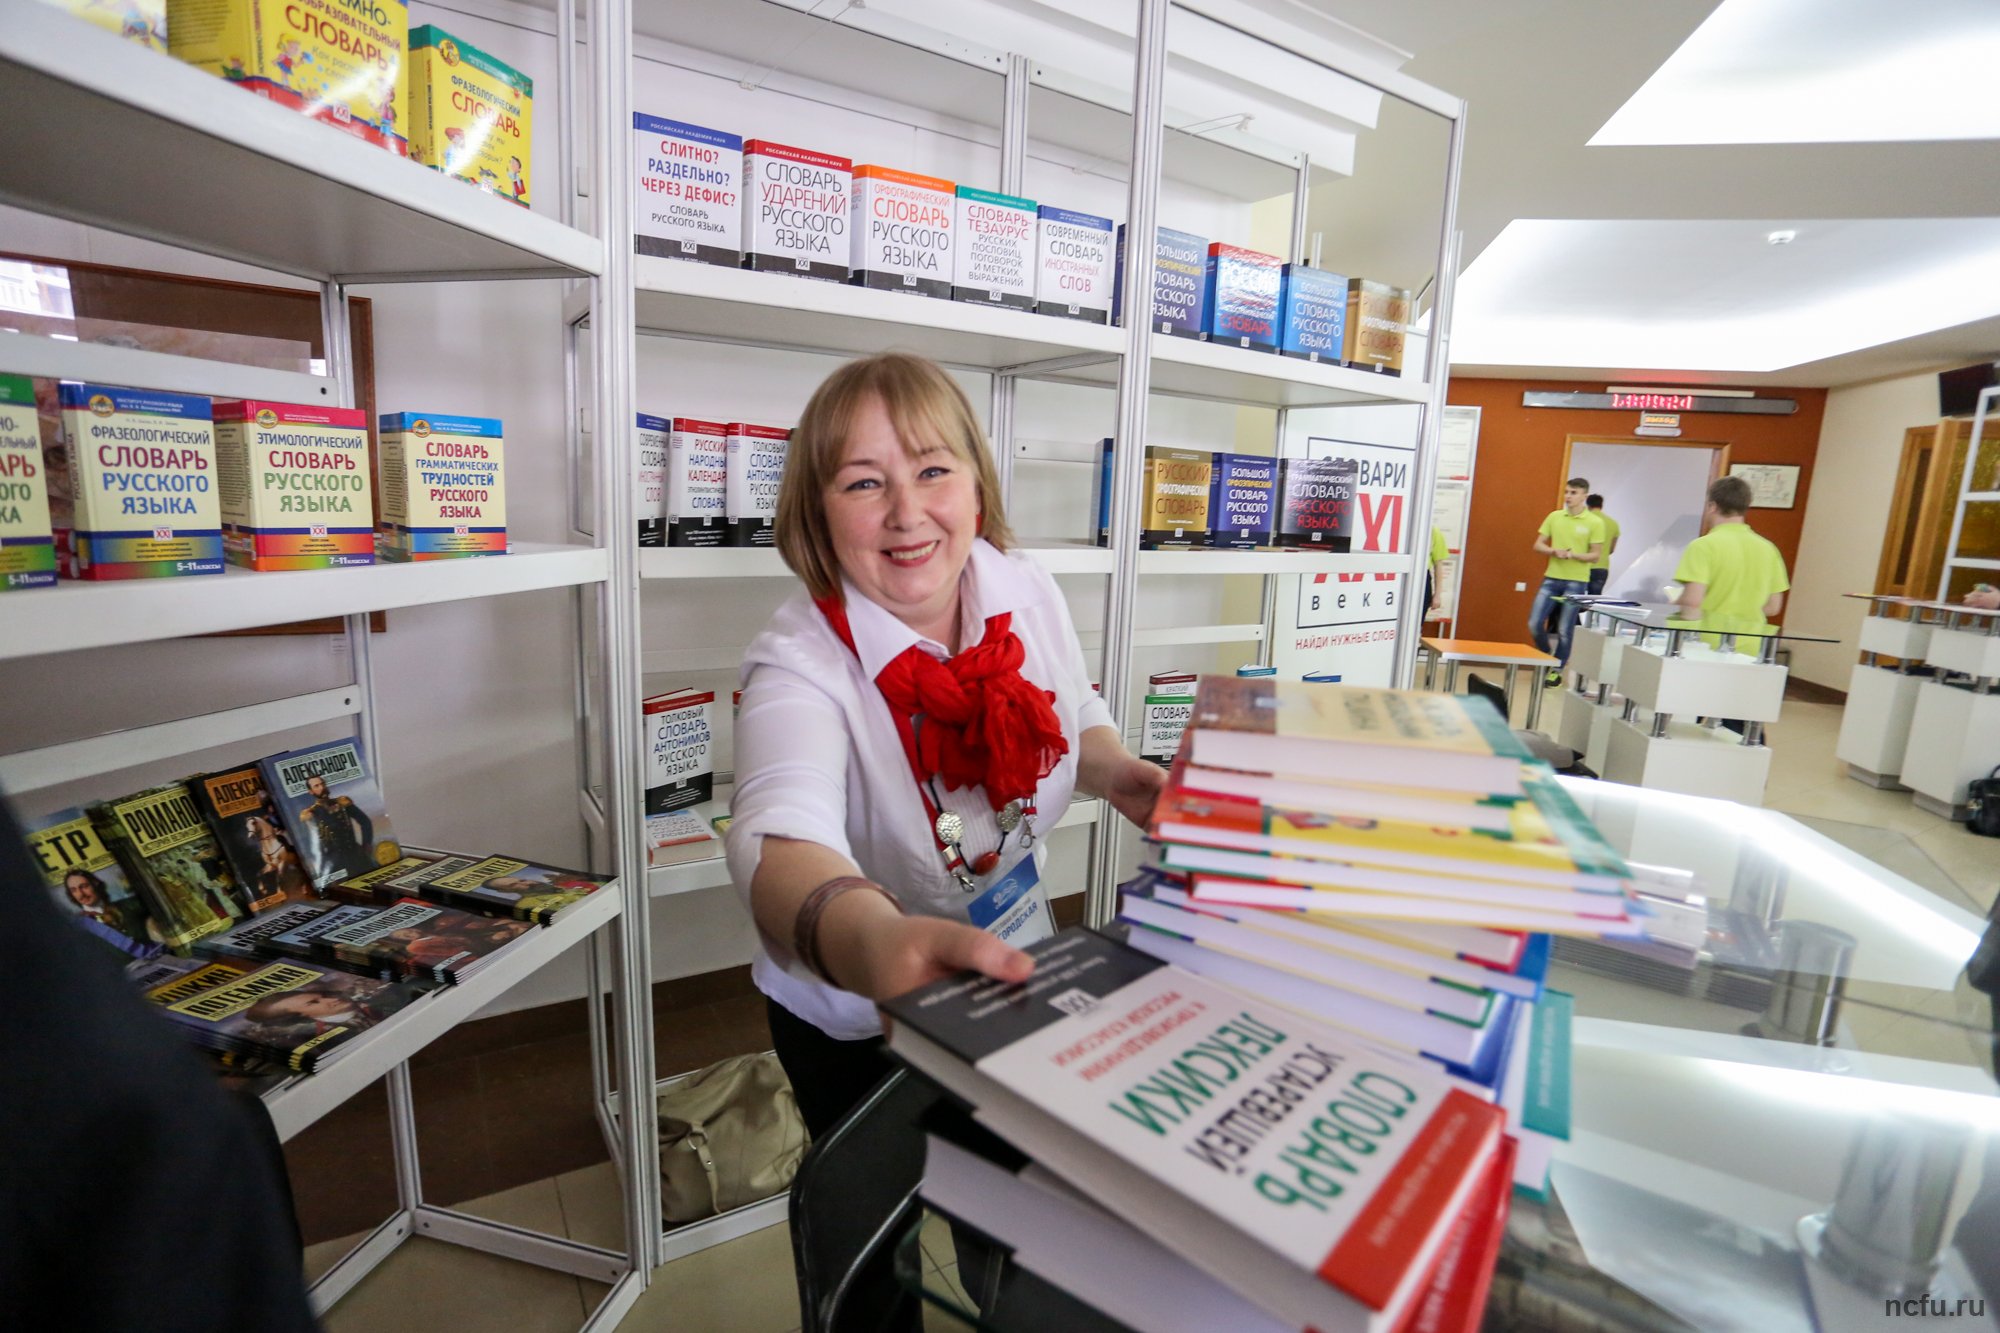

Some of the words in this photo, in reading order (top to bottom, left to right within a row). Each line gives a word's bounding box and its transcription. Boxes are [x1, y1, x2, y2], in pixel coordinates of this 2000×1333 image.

[285, 5, 388, 71] СЛОВАРЬ
[451, 75, 520, 116] ФРАЗЕОЛОГИЧЕСКИЙ
[661, 140, 719, 165] СЛИТНО?
[648, 158, 730, 186] РАЗДЕЛЬНО?
[766, 162, 842, 192] СЛОВАРЬ
[641, 176, 681, 197] ЧЕРЕЗ
[684, 186, 736, 207] ДЕФИС?
[761, 182, 846, 216] УДАРЕНИЙ
[874, 183, 950, 207] ОРФОГРАФИЧЕСКИЙ
[669, 204, 709, 220] СЛОВАРЬ
[762, 205, 844, 235] РУССКОГО
[874, 197, 949, 228] СЛОВАРЬ
[968, 205, 1032, 227] СЛОВАРЬ-
[651, 213, 695, 229] РУССКОГО
[697, 221, 725, 234] ЯЗЫКА
[968, 218, 1029, 240] ТЕЗАУРУС
[775, 229, 831, 254] ЯЗЫКА
[872, 220, 949, 251] РУССКОГО
[979, 234, 1017, 248] РУССКИХ
[1046, 224, 1109, 246] СОВРЕМЕННЫЙ
[682, 241, 696, 251] XXI
[1050, 240, 1104, 263] СЛОВАРЬ
[882, 245, 938, 271] ЯЗЫКА
[971, 252, 1023, 268] ПОГОВОРОК
[1045, 257, 1100, 277] ИНОСТРАННЫХ
[968, 271, 1024, 287] ВЫРАЖЕНИЙ
[974, 262, 981, 271] И
[983, 264, 1019, 277] МЕТКИХ
[1059, 274, 1091, 293] СЛОВ
[1154, 270, 1196, 291] ЛОВАРЬ
[1152, 286, 1196, 307] УССКОГО
[1295, 302, 1340, 322] СЛОВАРЬ
[1220, 313, 1272, 336] СЛОВАРЬ
[1292, 316, 1341, 337] РУССКОГО
[1298, 332, 1332, 351] ЯЗЫКА
[91, 424, 210, 445] ФРАЗЕОЛОГИЧЕСКИЙ
[257, 432, 363, 449] ЭТИМОЛОГИЧЕСКИЙ
[426, 442, 488, 459] СЛОВАРЬ
[752, 441, 786, 453] ТОЛКОВЫЙ
[98, 445, 208, 470] СЛОВАРЬ
[269, 450, 355, 470] СЛОВАРЬ
[416, 458, 499, 471] ГРАММАТИЧЕСКИХ
[689, 454, 726, 468] НАРОДНЫ
[750, 453, 784, 468] СЛОВАР
[102, 472, 209, 492] РУССКОГО
[264, 472, 363, 492] РУССКОГО
[421, 472, 494, 487] ТРУДНОСТЕЙ
[688, 470, 726, 482] КАЛЕНДАР
[747, 469, 783, 481] АНТОНИМ
[1157, 463, 1209, 481] РУССКИЙ
[1231, 467, 1270, 479] БОЛЬШОЙ
[430, 489, 488, 502] РУССКОГО
[750, 483, 778, 495] РУССКО
[1229, 489, 1268, 501] СЛОВАРЬ
[1292, 484, 1350, 499] СЛОВАРЬ
[121, 496, 197, 515] ЯЗЫКА
[280, 495, 352, 513] ЯЗЫКА
[439, 505, 481, 518] ЯЗЫКА
[692, 497, 725, 508] СЛОВАРЬ
[756, 497, 776, 509] ЯЗЫК
[1156, 498, 1205, 516] СЛОВАРЬ
[1226, 502, 1268, 513] РУССКОГО
[1288, 499, 1352, 515] РУССКОГО
[1231, 515, 1261, 525] ЯЗЫКА
[1296, 514, 1341, 529] ЯЗЫКА
[156, 530, 170, 538] XXI
[312, 527, 325, 535] XXI
[1295, 636, 1329, 650] НАЙДИ
[1331, 632, 1370, 647] НУЖНЫЕ
[1372, 629, 1395, 642] СЛОВ
[660, 705, 704, 724] ТОЛКОВЫЙ
[1152, 707, 1190, 719] СЛОВАРЬ
[657, 718, 708, 740] СЛОВАРЬ
[1152, 731, 1182, 740] НАЗВАНИ
[653, 730, 711, 754] АНТОНИМОВ
[658, 744, 706, 765] РУССКОГО
[282, 756, 348, 785] АЛЕКСАНДР
[346, 751, 358, 768] II
[665, 758, 699, 777] ЯЗЫКА
[213, 774, 264, 804] АЛЕКСА
[123, 794, 202, 844] РОМАНО
[35, 829, 90, 874] ЕТР
[155, 968, 240, 1003] УШКИН
[184, 967, 307, 1016] ПОТЕМКИН
[1126, 990, 1183, 1025] РУССКОЙ
[1052, 1019, 1129, 1067] КЛАССИКИ
[1079, 1008, 1198, 1082] ПРОИЗВЕДЕНИЯМ
[1109, 1012, 1288, 1136] ЛЕКСИКИ
[1184, 1043, 1345, 1176] УСТАРЕВШЕЙ
[1253, 1071, 1418, 1213] СЛОВАРЬ
